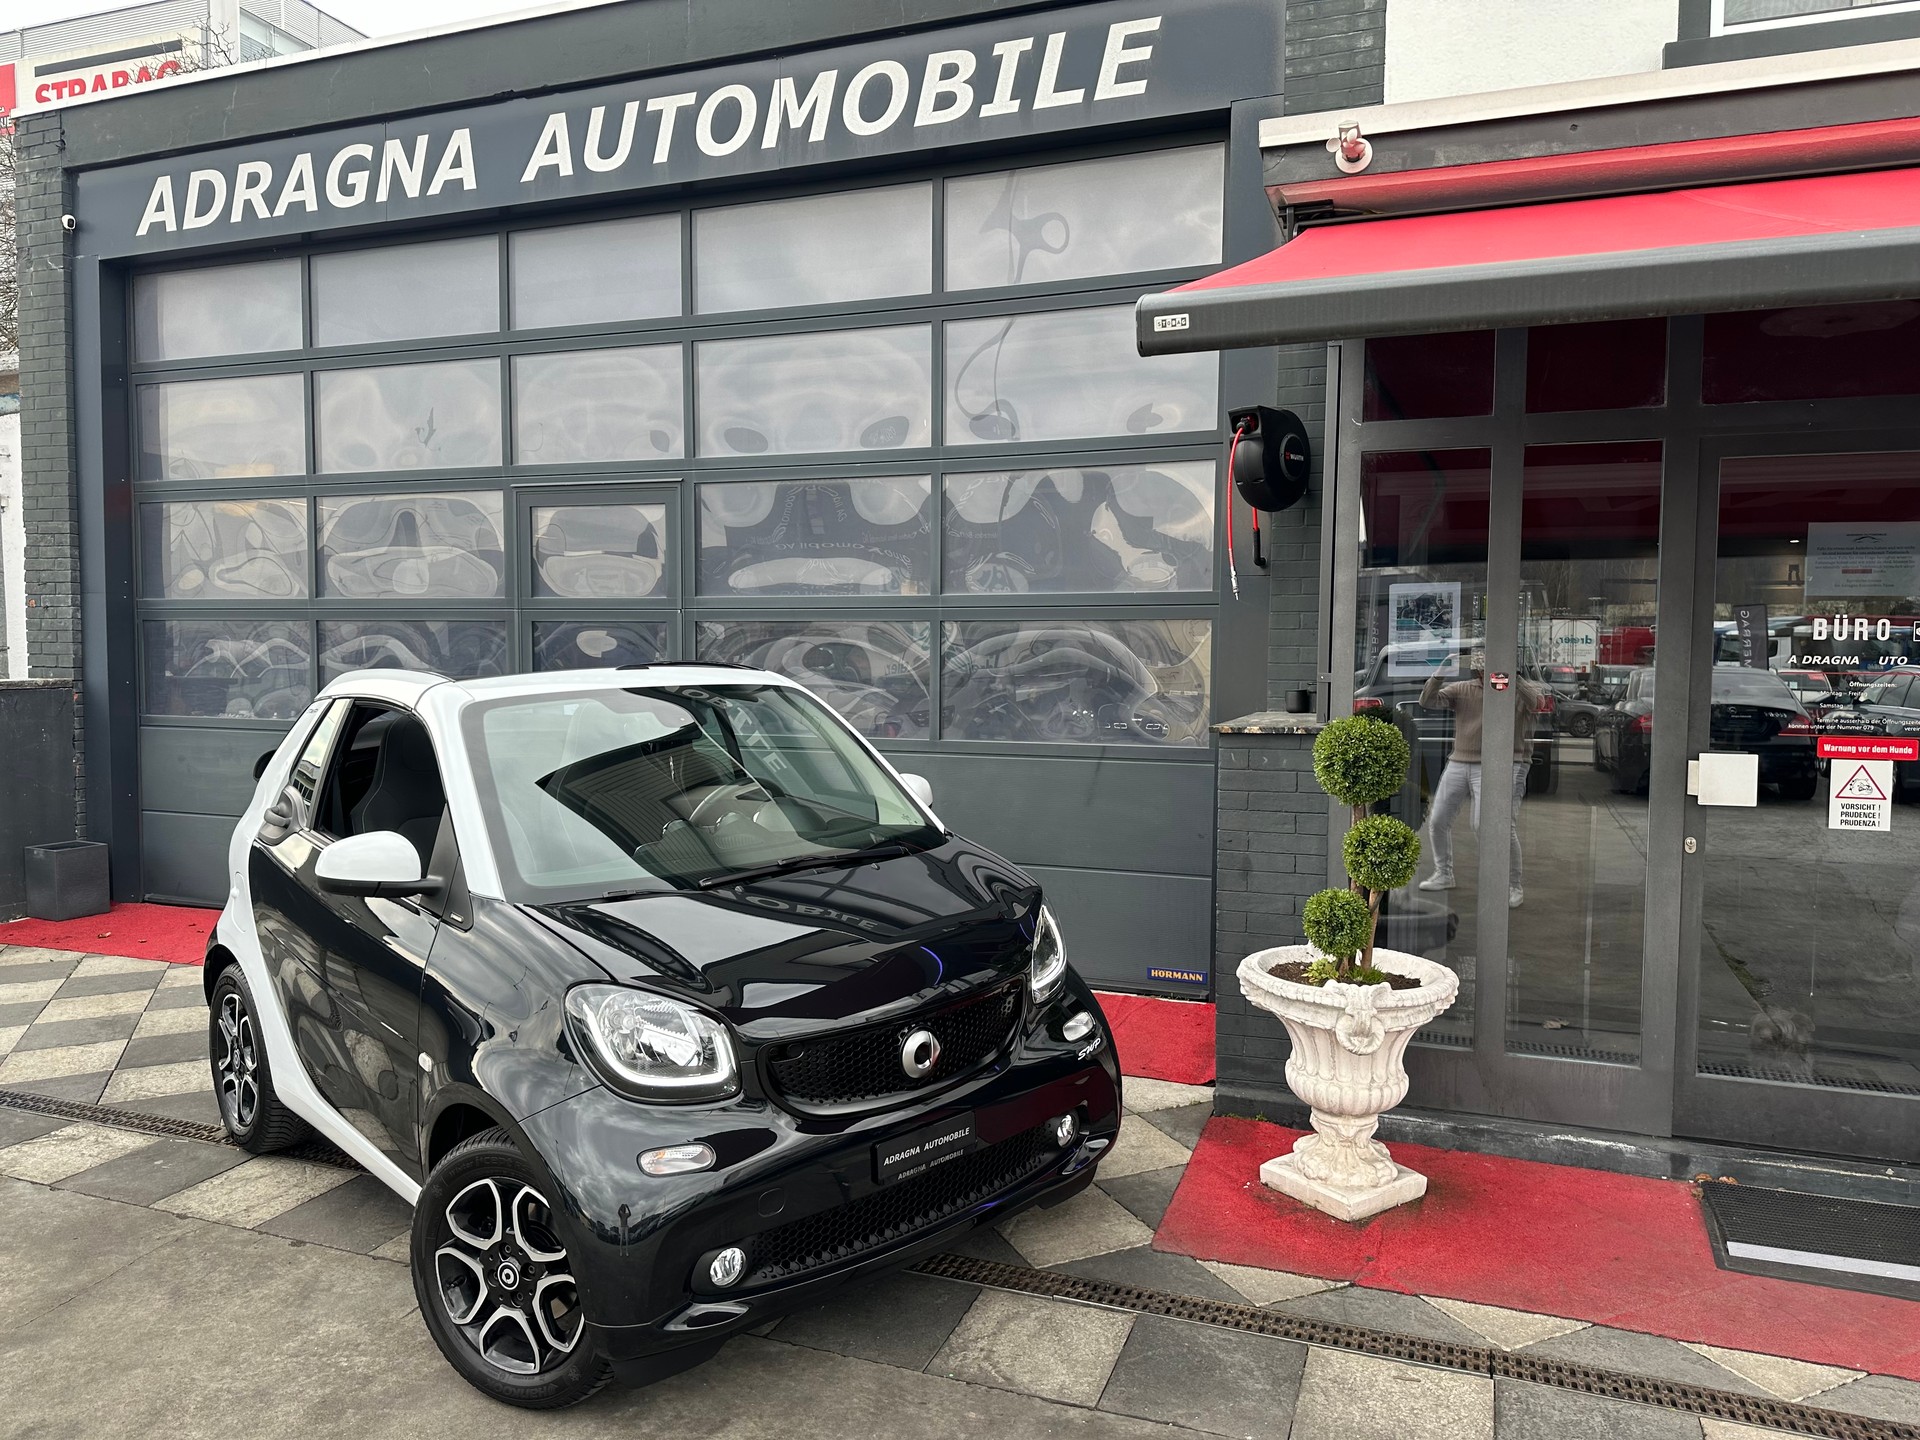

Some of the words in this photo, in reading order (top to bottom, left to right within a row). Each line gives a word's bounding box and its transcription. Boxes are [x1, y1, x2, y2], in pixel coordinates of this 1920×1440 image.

[135, 128, 477, 236] ADRAGNA
[520, 15, 1162, 184] AUTOMOBILE
[1812, 614, 1891, 641] BÜRO
[1802, 655, 1860, 665] DRAGNA
[1878, 656, 1908, 666] UTO
[1823, 743, 1856, 754] Warnung
[1872, 745, 1888, 753] dem
[1889, 745, 1913, 754] Hunde
[1840, 803, 1876, 811] VORSICHT
[1840, 811, 1876, 819] PRUDENCE
[1840, 819, 1876, 827] PRUDENZA
[883, 1145, 920, 1166] ADRAGNA
[923, 1127, 970, 1151] AUTOMOBILE
